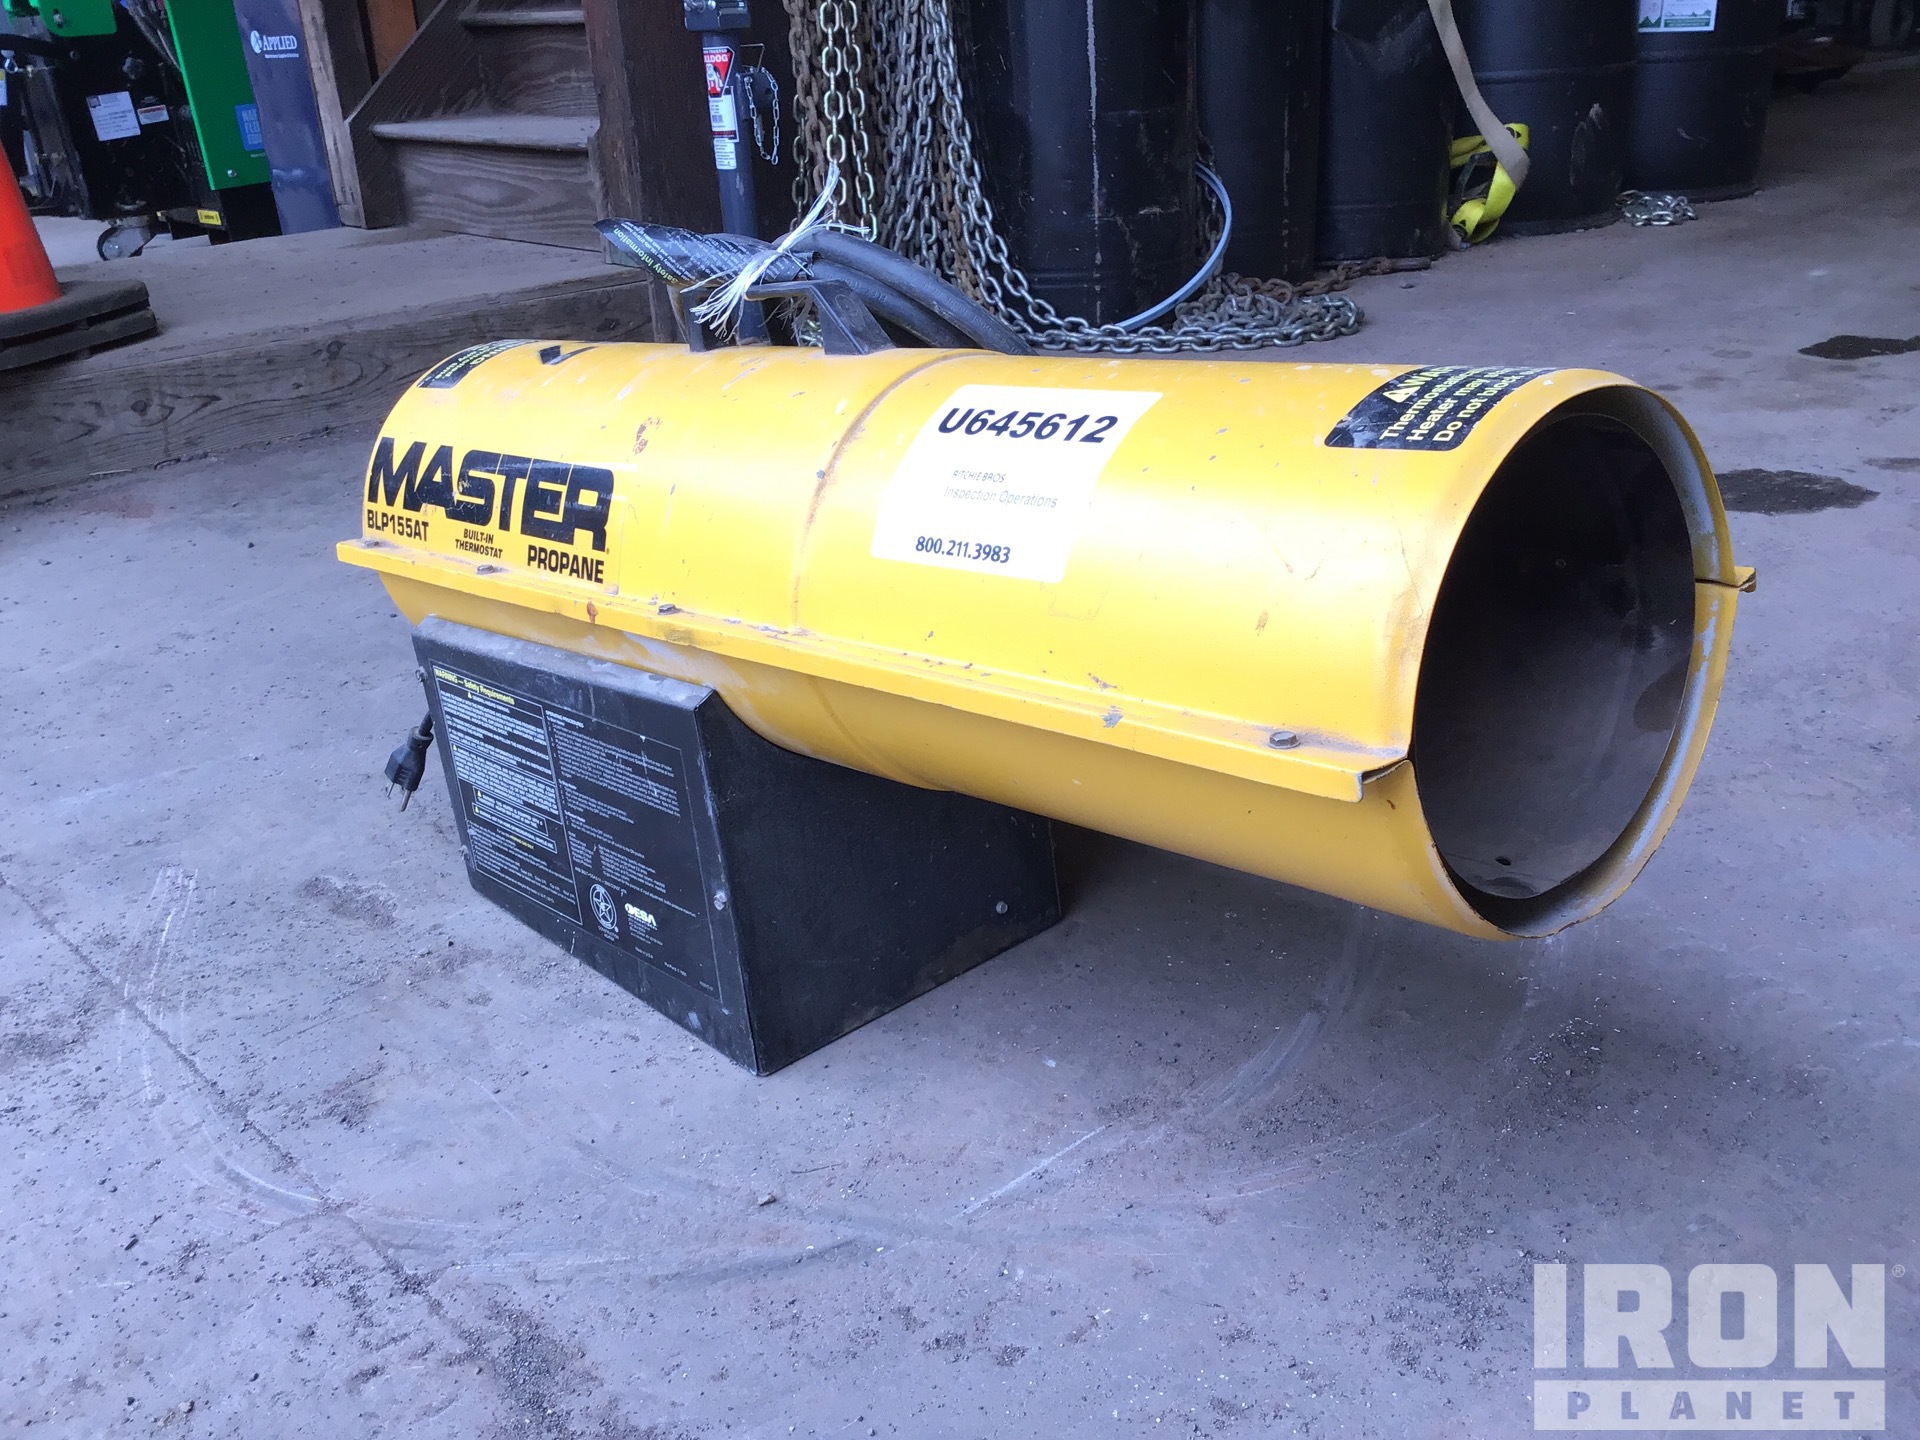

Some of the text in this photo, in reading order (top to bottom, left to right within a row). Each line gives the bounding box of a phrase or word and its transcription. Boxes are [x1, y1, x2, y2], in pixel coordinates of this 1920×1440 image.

[262, 35, 298, 51] APPLIED
[612, 228, 655, 267] Information
[652, 262, 679, 285] Safety
[1405, 379, 1491, 441] Heater may
[1432, 421, 1463, 441] Do
[1457, 398, 1488, 418] not
[1477, 375, 1525, 396] block
[938, 407, 1119, 443] U645612
[952, 469, 981, 482] RITCHIE
[367, 436, 615, 553] MASTER
[943, 486, 1058, 509] Inspection Operations
[366, 508, 429, 542] BLP155AT
[463, 528, 494, 545] BUILT-IN
[454, 538, 504, 559] THERMOSTAT
[527, 544, 605, 584] PROPANE
[915, 535, 1011, 564] 800.211.3983
